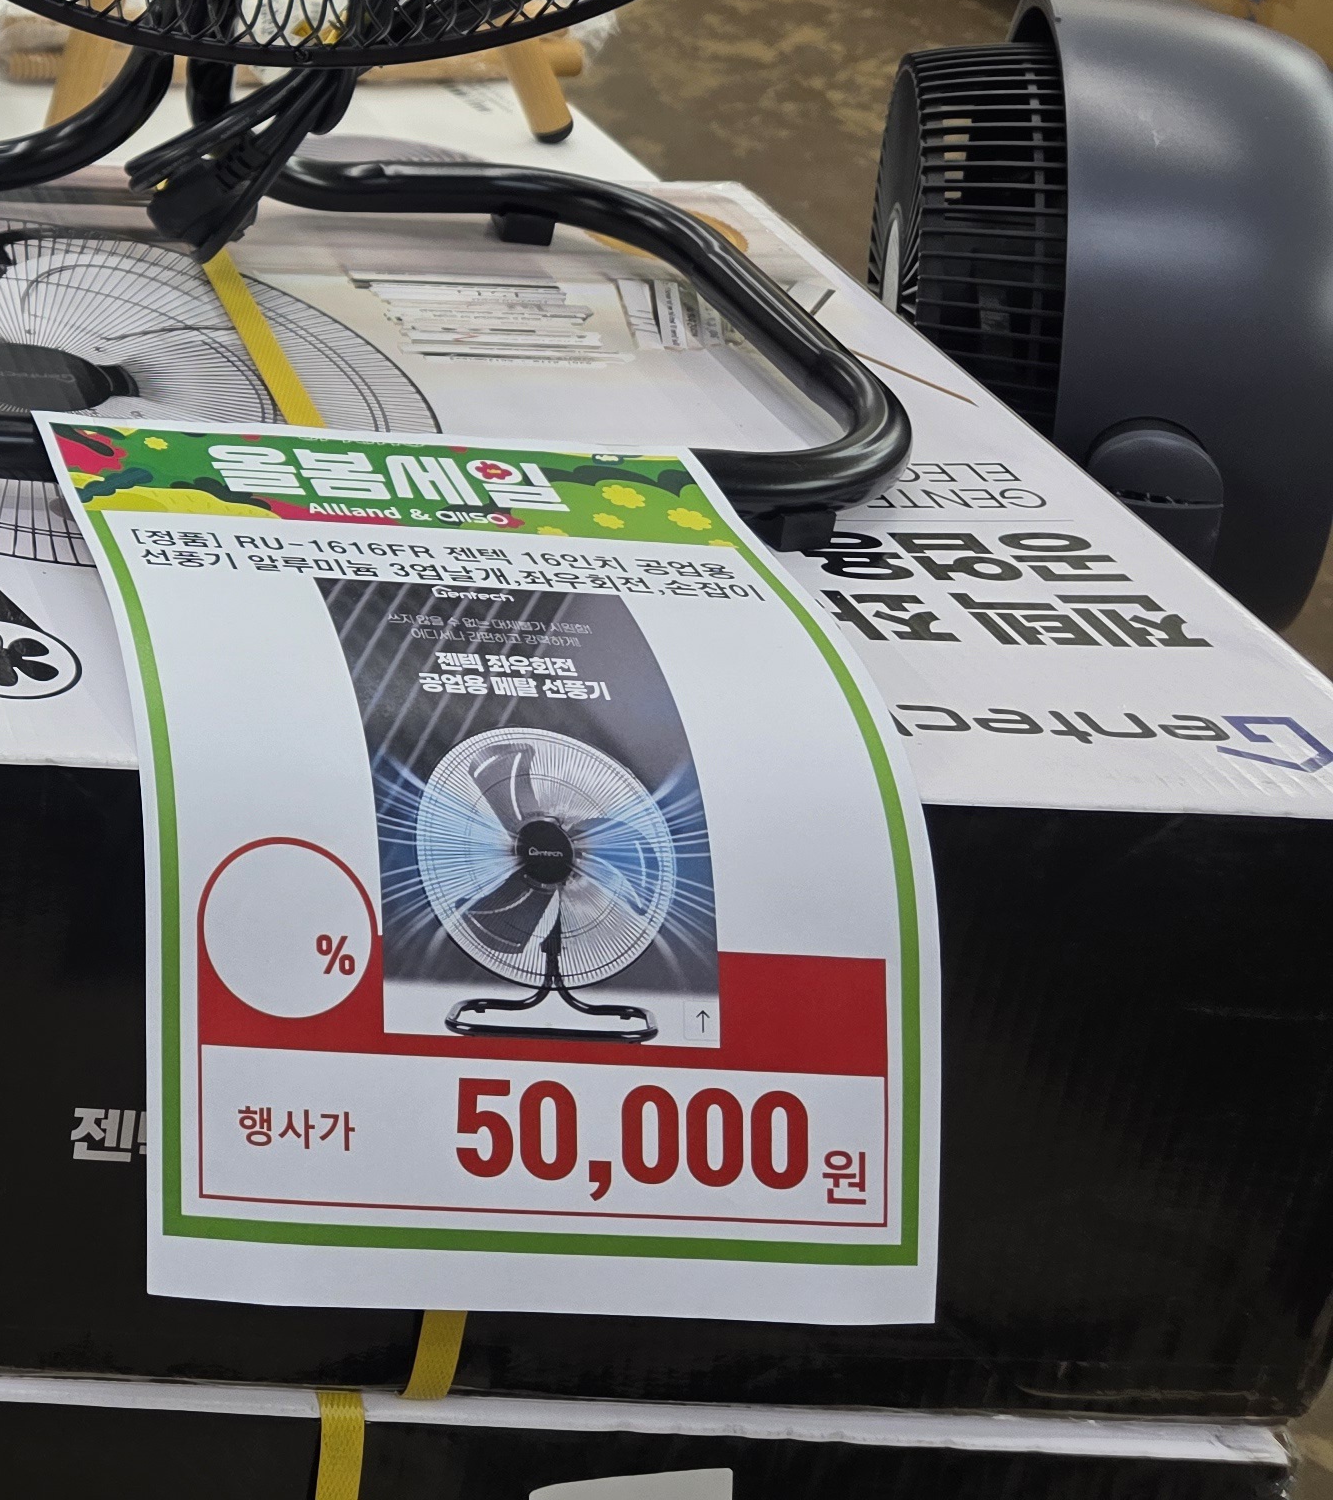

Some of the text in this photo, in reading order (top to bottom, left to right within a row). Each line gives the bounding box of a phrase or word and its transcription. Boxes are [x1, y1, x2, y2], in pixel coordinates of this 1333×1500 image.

[208, 444, 570, 512] 올봄세일
[309, 501, 400, 520] Allland
[410, 508, 432, 521] &
[131, 528, 735, 580] [정품] RU-1616FR 젠텍 16인치 공업용
[141, 548, 238, 570] 선풍기
[247, 553, 379, 578] 알루미늄
[431, 585, 514, 602] Gentech
[387, 613, 414, 624] 쓰지
[948, 592, 1214, 648] 젠텍
[411, 628, 465, 641] 어디서나
[467, 631, 523, 644] 간편하고
[435, 651, 578, 677] 젠텍 좌우회전
[418, 672, 612, 701] 공업용 메탈 선풍기
[315, 933, 357, 978] %
[70, 1107, 147, 1163] 젠
[237, 1075, 870, 1207] 행사가 50,000 원
